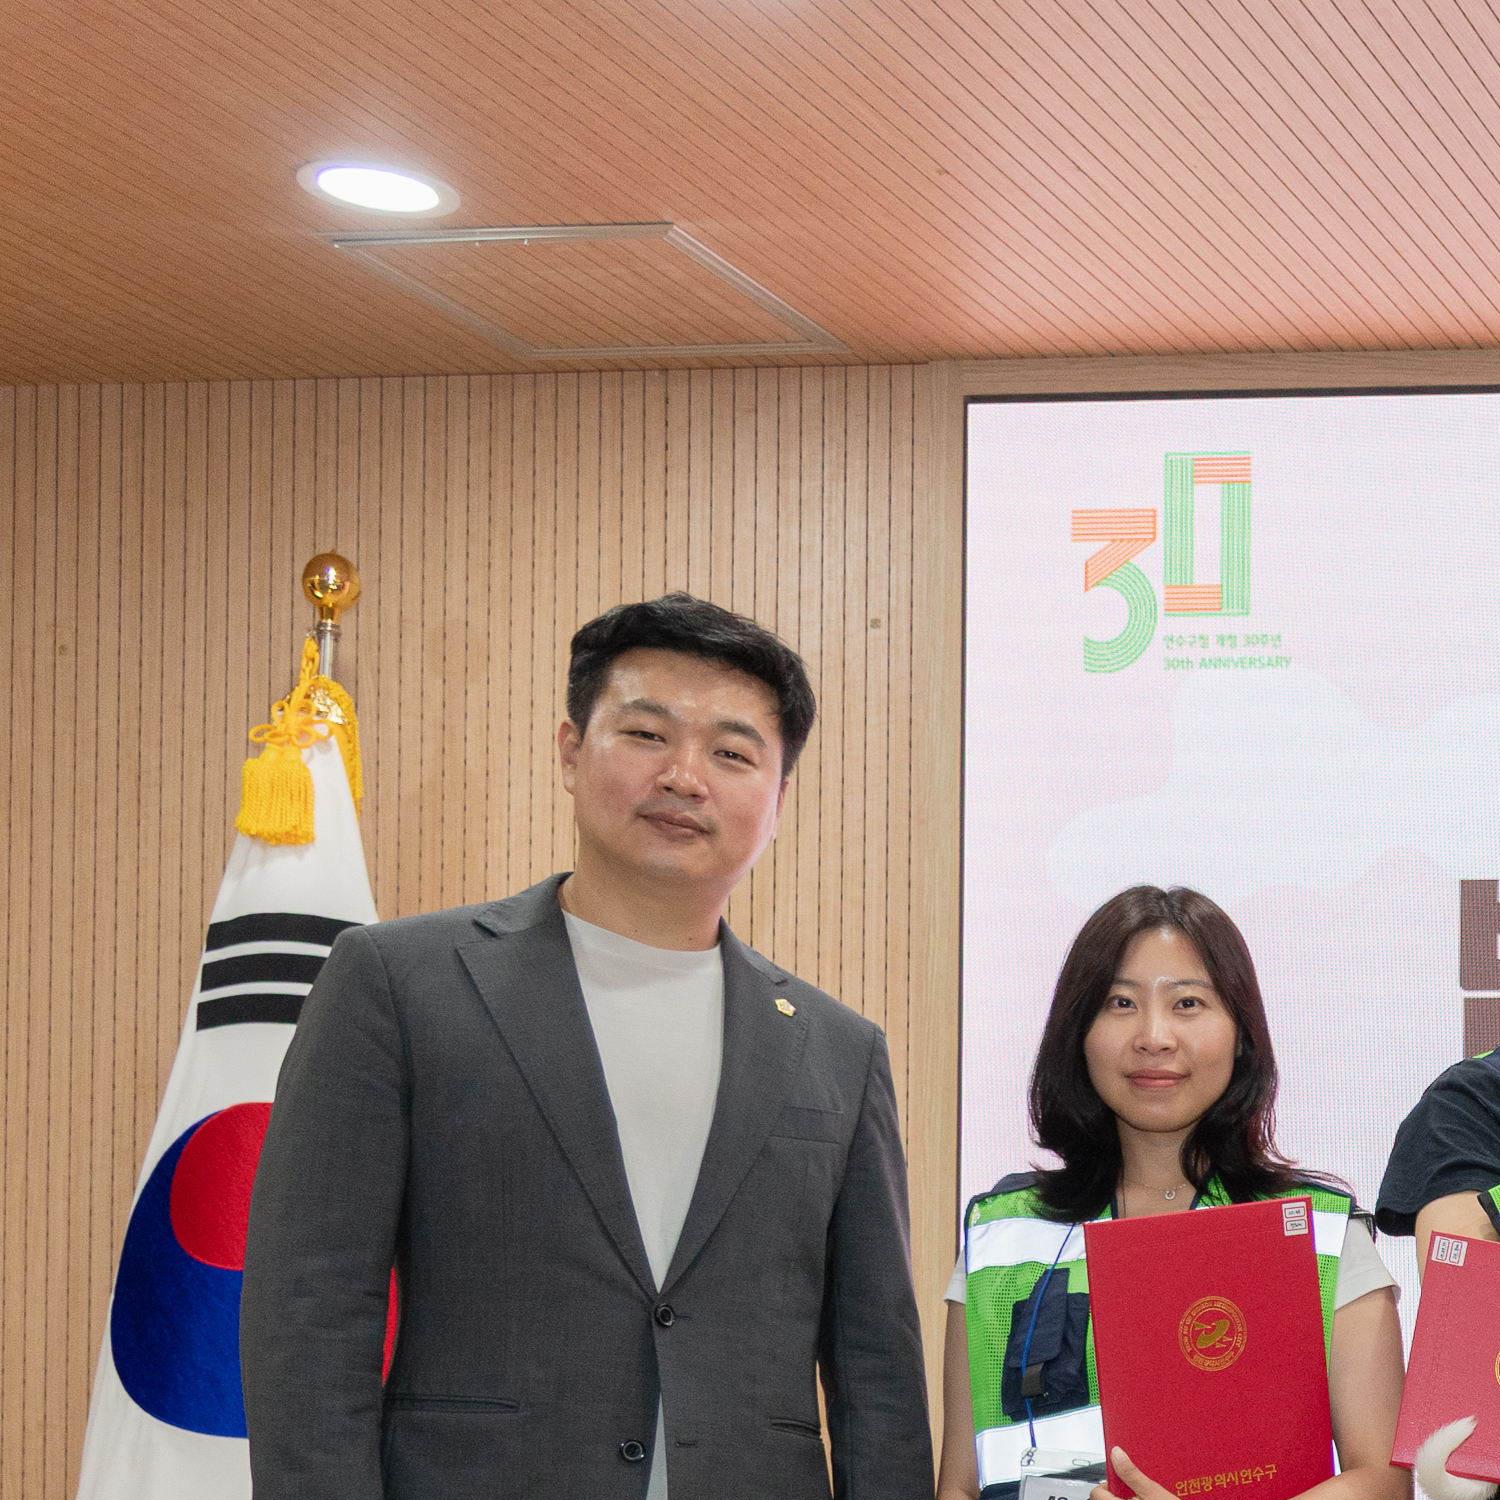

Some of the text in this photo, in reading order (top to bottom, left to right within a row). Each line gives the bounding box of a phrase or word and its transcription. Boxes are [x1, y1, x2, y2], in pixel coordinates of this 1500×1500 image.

[1164, 655, 1292, 671] 30th ANNIVERSARY
[1175, 1464, 1277, 1497] 인천광역시연수구
